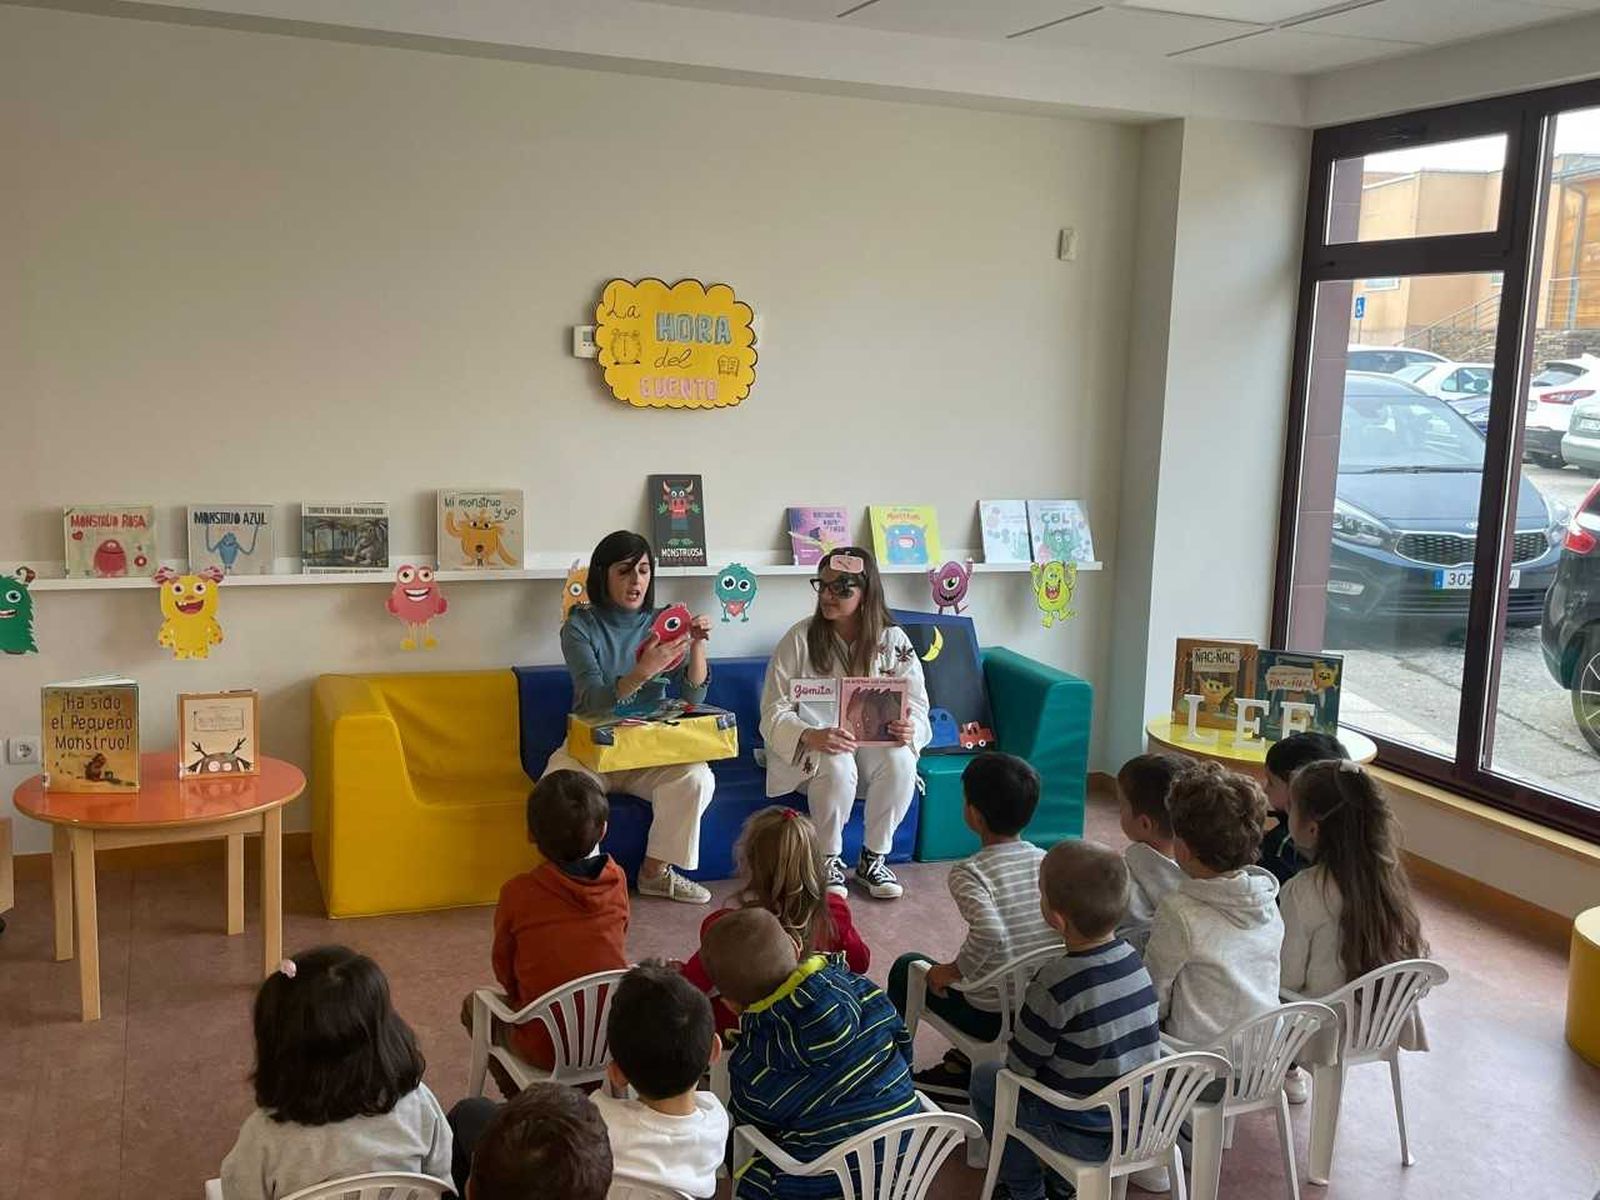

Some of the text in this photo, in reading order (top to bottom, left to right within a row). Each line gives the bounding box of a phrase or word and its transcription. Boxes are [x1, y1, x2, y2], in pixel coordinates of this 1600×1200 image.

[606, 288, 640, 320] La
[656, 312, 732, 345] HORA
[653, 347, 693, 369] del
[458, 496, 501, 508] monstruo
[70, 514, 146, 528] MONSTRUO ROSA
[194, 511, 268, 525] MONSTRUO AZUL
[504, 508, 517, 521] yo
[661, 548, 704, 557] MONSTRUOSA
[90, 695, 121, 710] sido
[52, 715, 64, 730] el
[55, 735, 130, 751] Monstruo!
